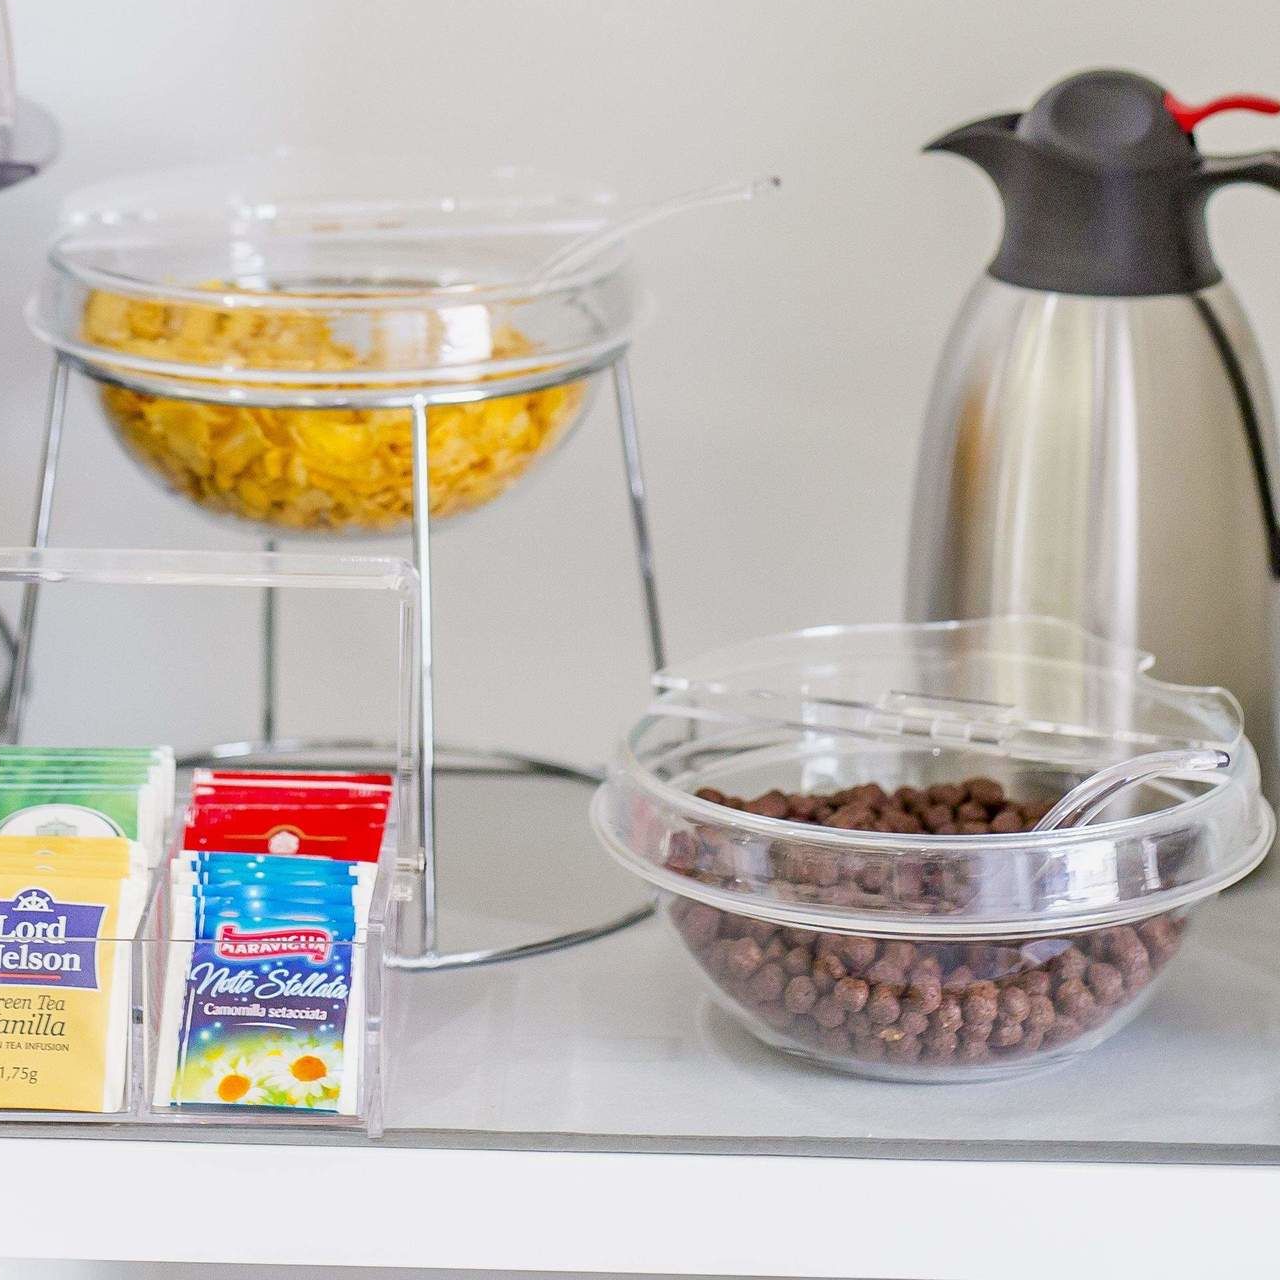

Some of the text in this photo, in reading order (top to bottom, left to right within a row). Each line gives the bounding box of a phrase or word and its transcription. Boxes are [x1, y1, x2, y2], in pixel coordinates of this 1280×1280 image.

[221, 935, 326, 954] MARAVIGLIA
[190, 962, 349, 999] Notte Stellata
[38, 994, 65, 1011] Tea
[204, 1002, 328, 1021] Camomilla setacciata
[6, 1040, 22, 1050] TEA
[25, 1041, 69, 1052] INFUSION
[0, 1066, 38, 1085] 1,75g
